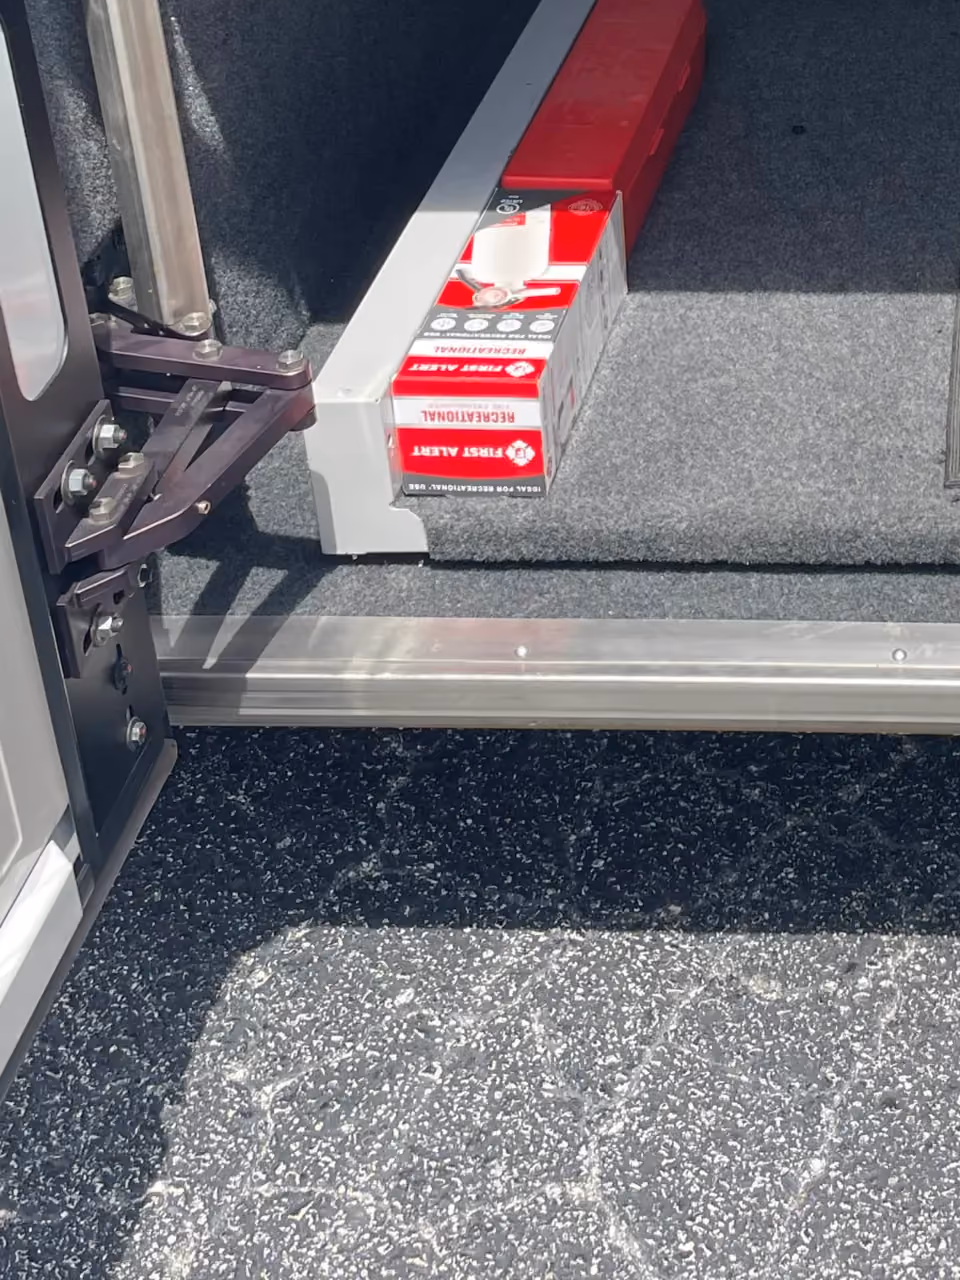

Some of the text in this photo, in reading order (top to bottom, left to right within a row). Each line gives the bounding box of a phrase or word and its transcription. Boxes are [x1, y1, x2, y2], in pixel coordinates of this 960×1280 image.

[434, 345, 527, 355] RECREATIONAL
[408, 363, 505, 372] FIRST ALERT
[421, 410, 515, 424] RECREATIONAL
[411, 445, 505, 458] FIRST ALERT
[409, 483, 426, 491] USE
[499, 485, 514, 493] FOR
[517, 485, 541, 493] IDEAL
